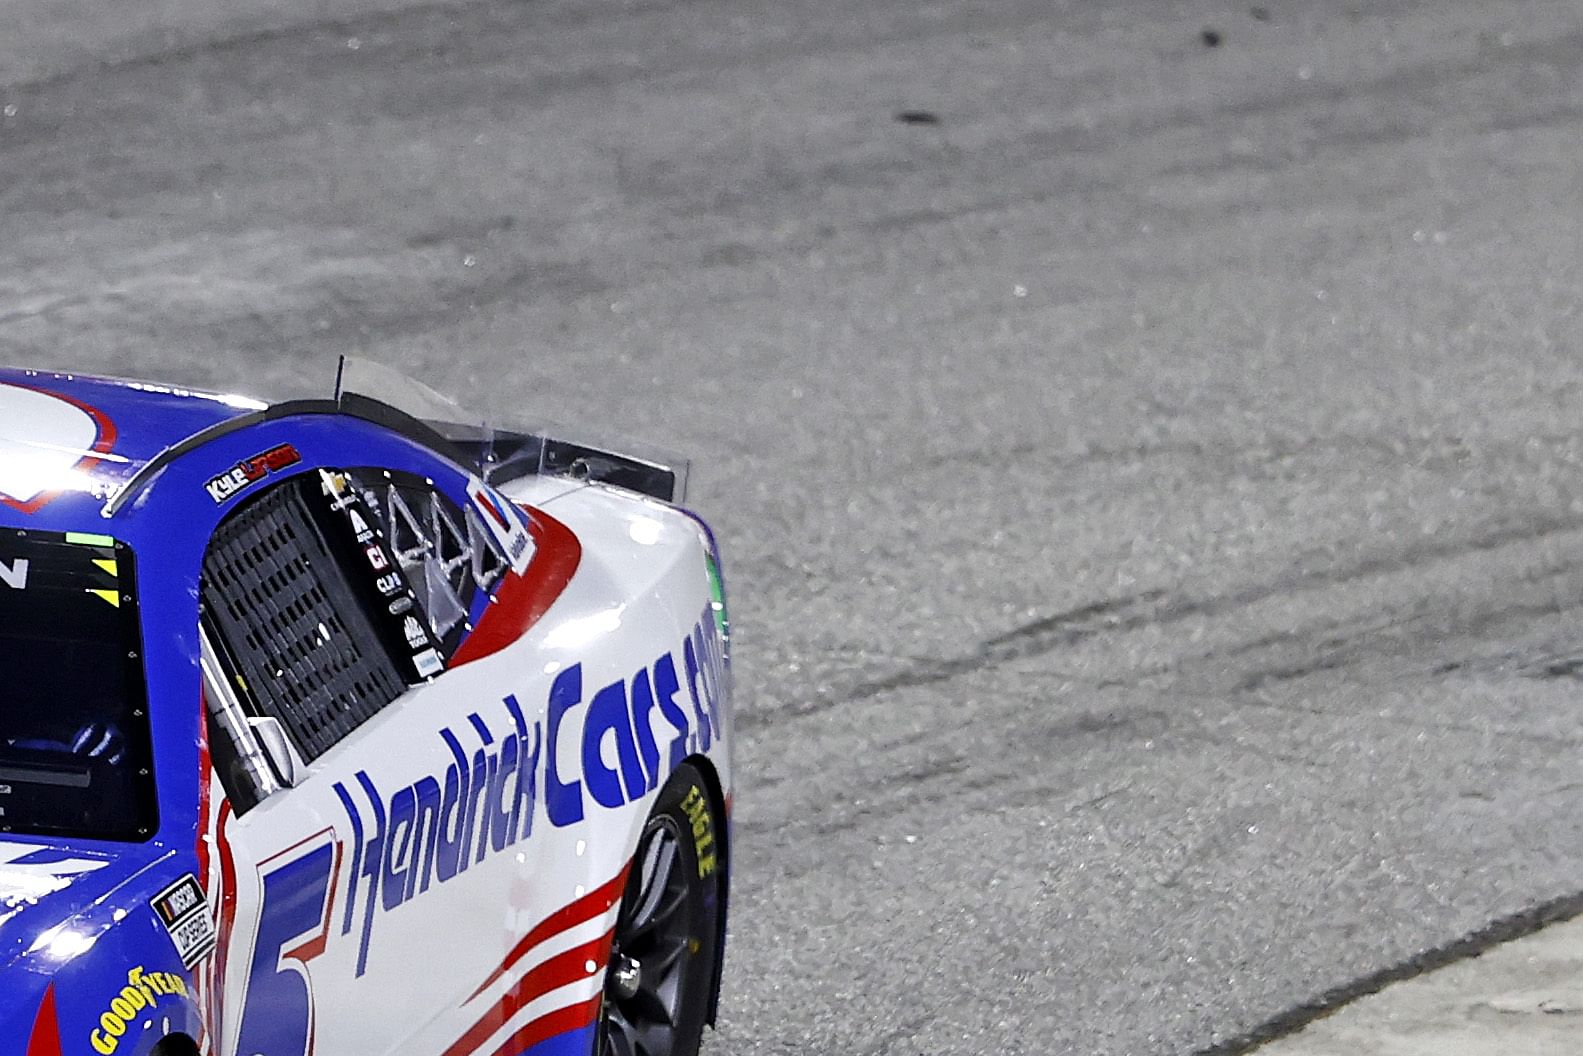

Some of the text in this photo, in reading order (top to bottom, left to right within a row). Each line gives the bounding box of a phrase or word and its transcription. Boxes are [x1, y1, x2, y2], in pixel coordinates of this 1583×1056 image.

[206, 468, 250, 503] KYLE
[680, 785, 715, 879] EAGLE
[91, 966, 189, 1055] GOODYEAR
